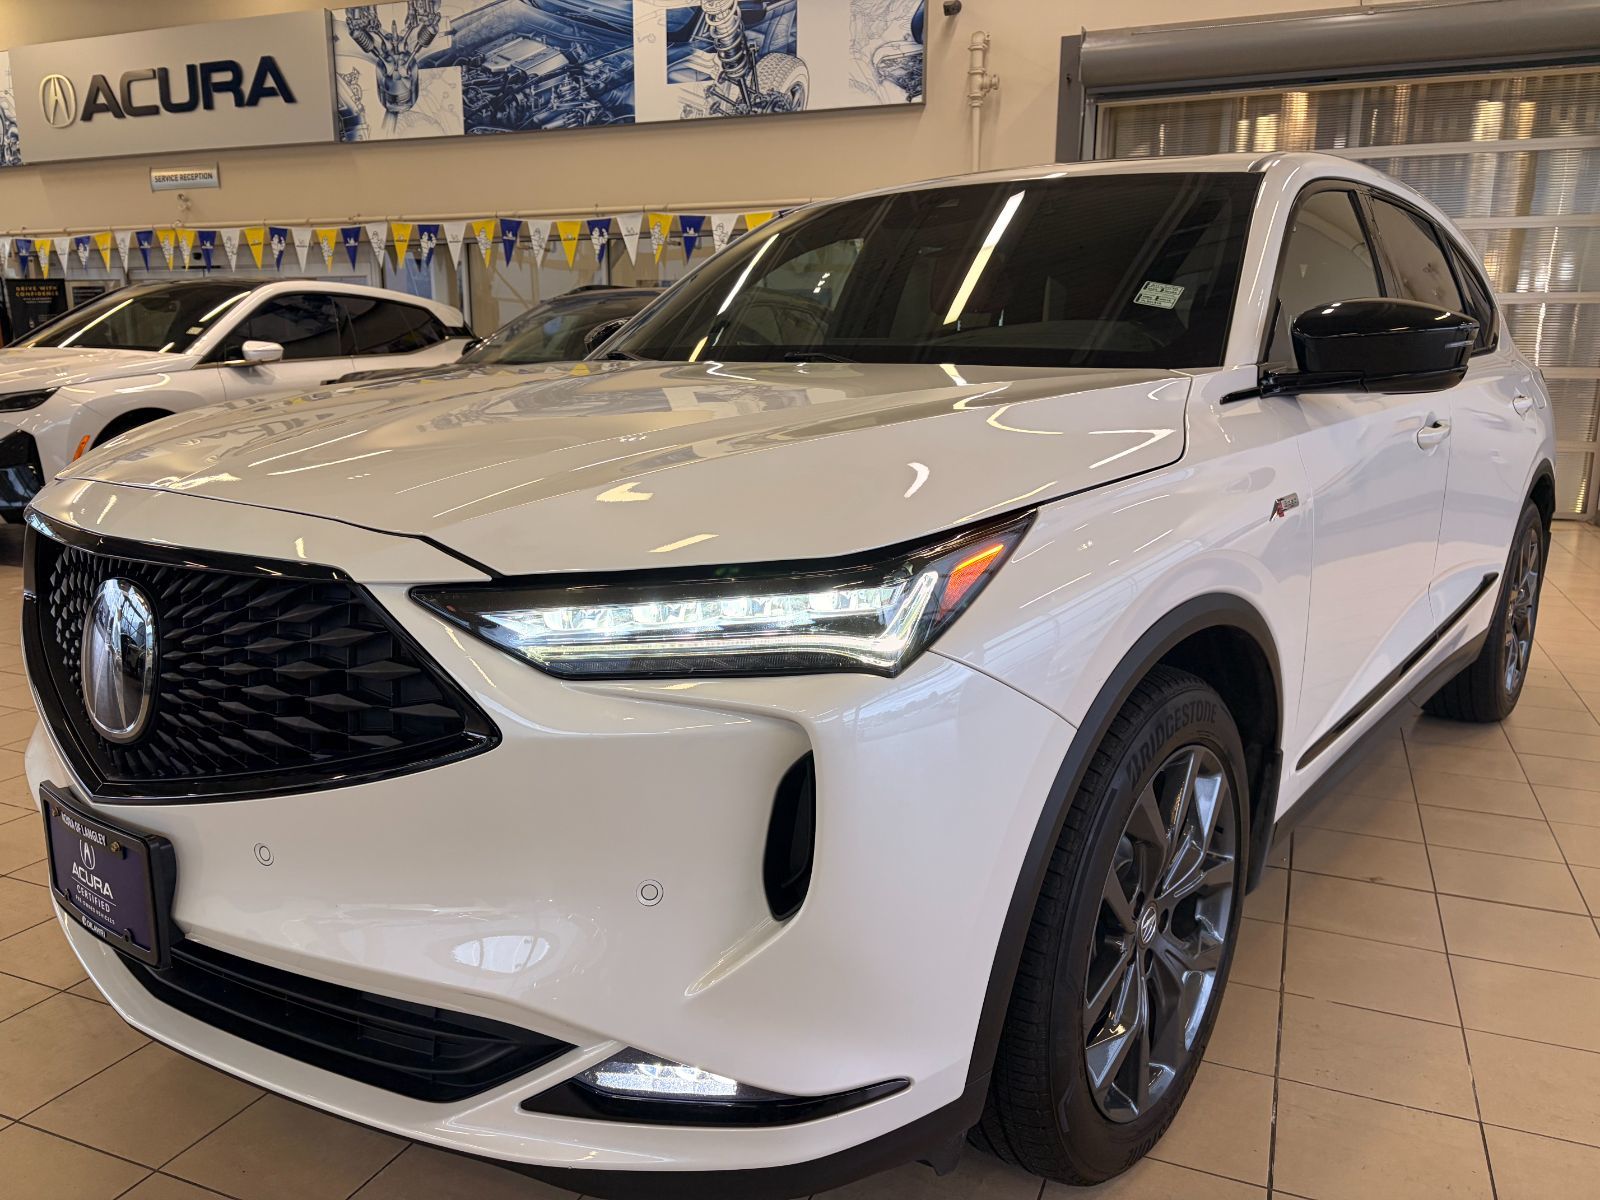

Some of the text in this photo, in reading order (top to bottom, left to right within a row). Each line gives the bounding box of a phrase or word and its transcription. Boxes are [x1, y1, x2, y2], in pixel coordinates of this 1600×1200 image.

[80, 55, 297, 121] ACURA
[154, 172, 213, 183] SERVICE RECEPTION
[1126, 701, 1217, 790] BRIDGESTONE
[81, 824, 106, 846] LANGLEY
[72, 861, 114, 900] ACURA
[76, 884, 110, 913] CERTIFIED
